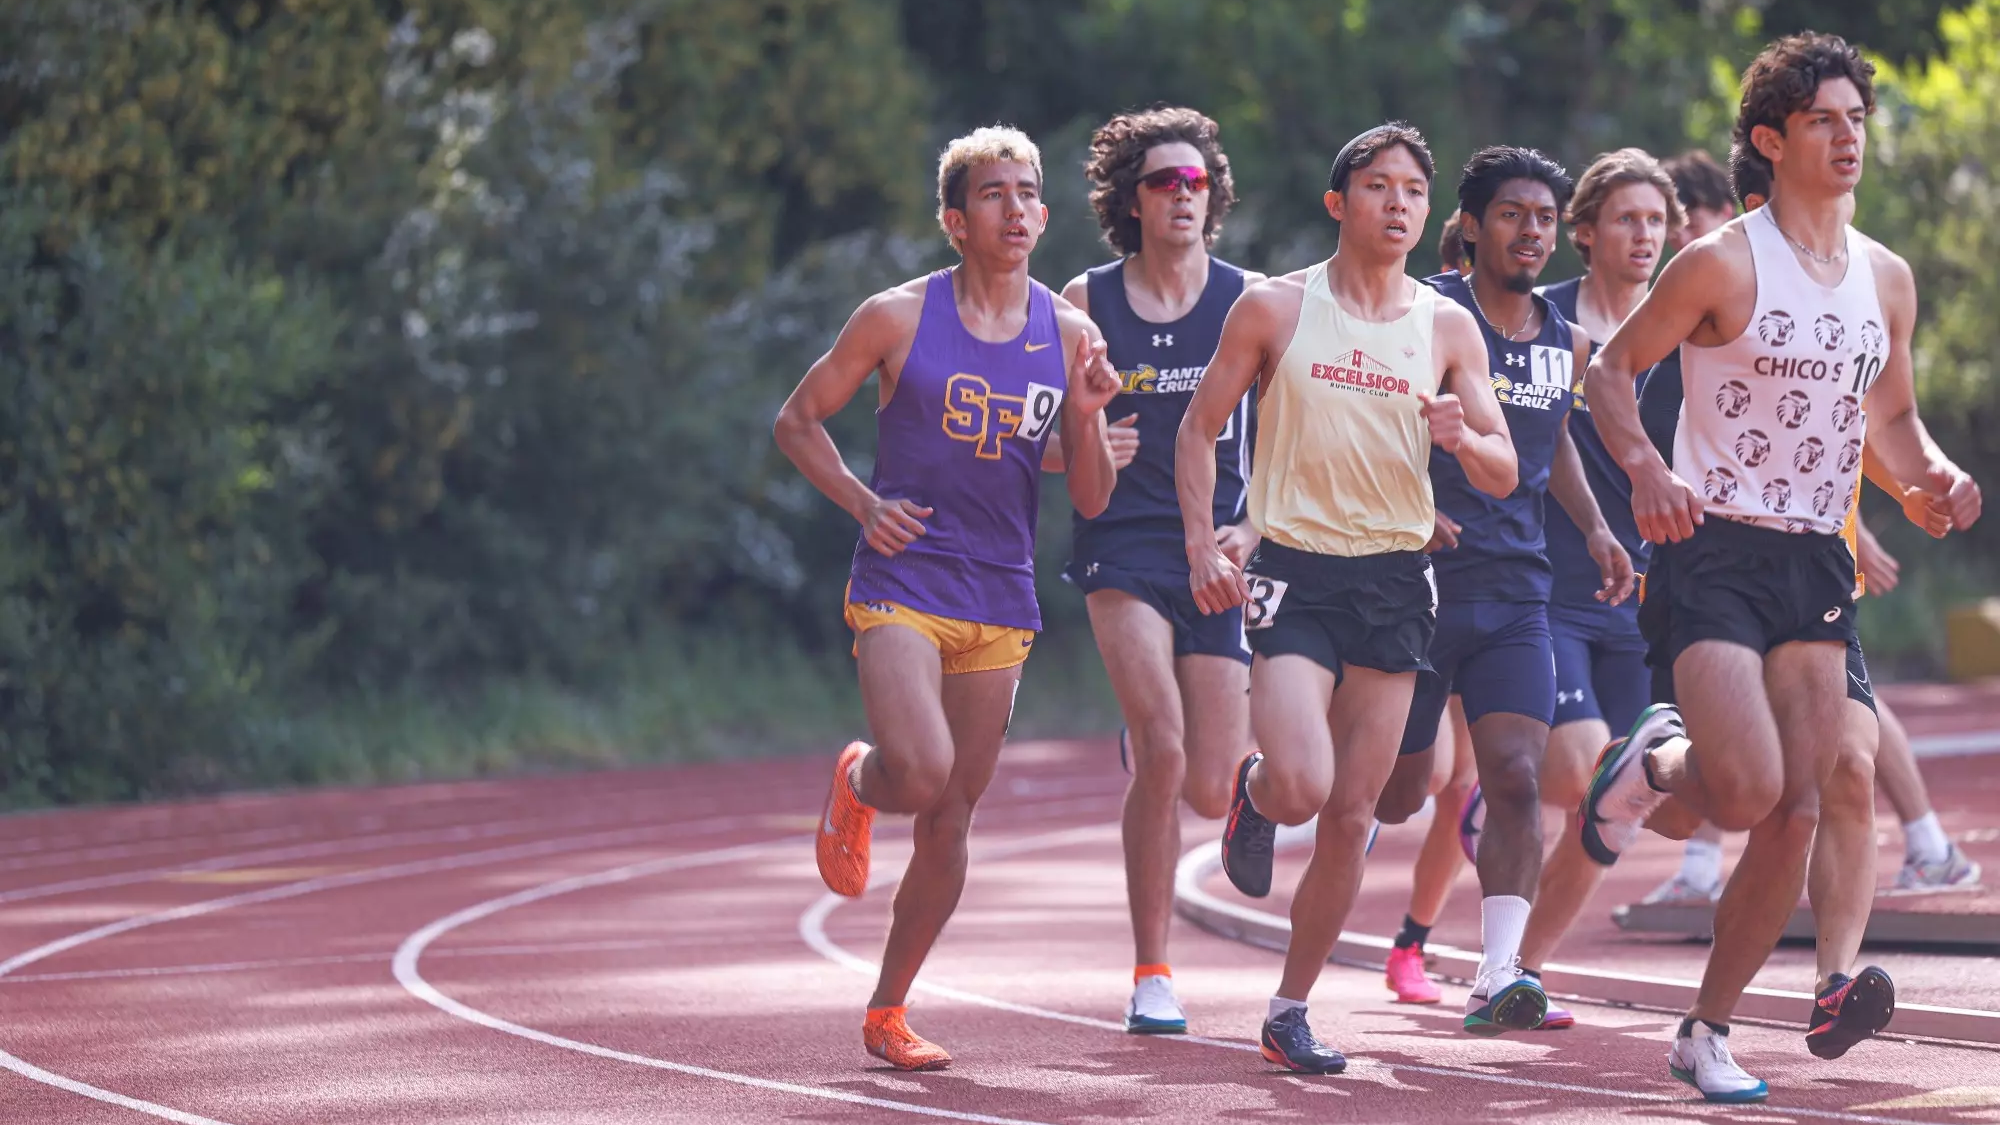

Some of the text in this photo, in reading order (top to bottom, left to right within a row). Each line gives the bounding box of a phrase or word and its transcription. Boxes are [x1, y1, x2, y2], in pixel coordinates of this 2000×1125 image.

[1311, 363, 1410, 395] EXCELSIOR
[1538, 348, 1566, 386] 11
[1754, 356, 1827, 381] CHICO
[1852, 352, 1880, 396] 10
[1156, 379, 1198, 393] CRUZ
[1330, 382, 1389, 398] RUNNING CLUB
[1512, 382, 1562, 401] SANTA
[942, 372, 1025, 460] SF
[1027, 390, 1055, 438] 9
[1511, 394, 1552, 411] CRUZ
